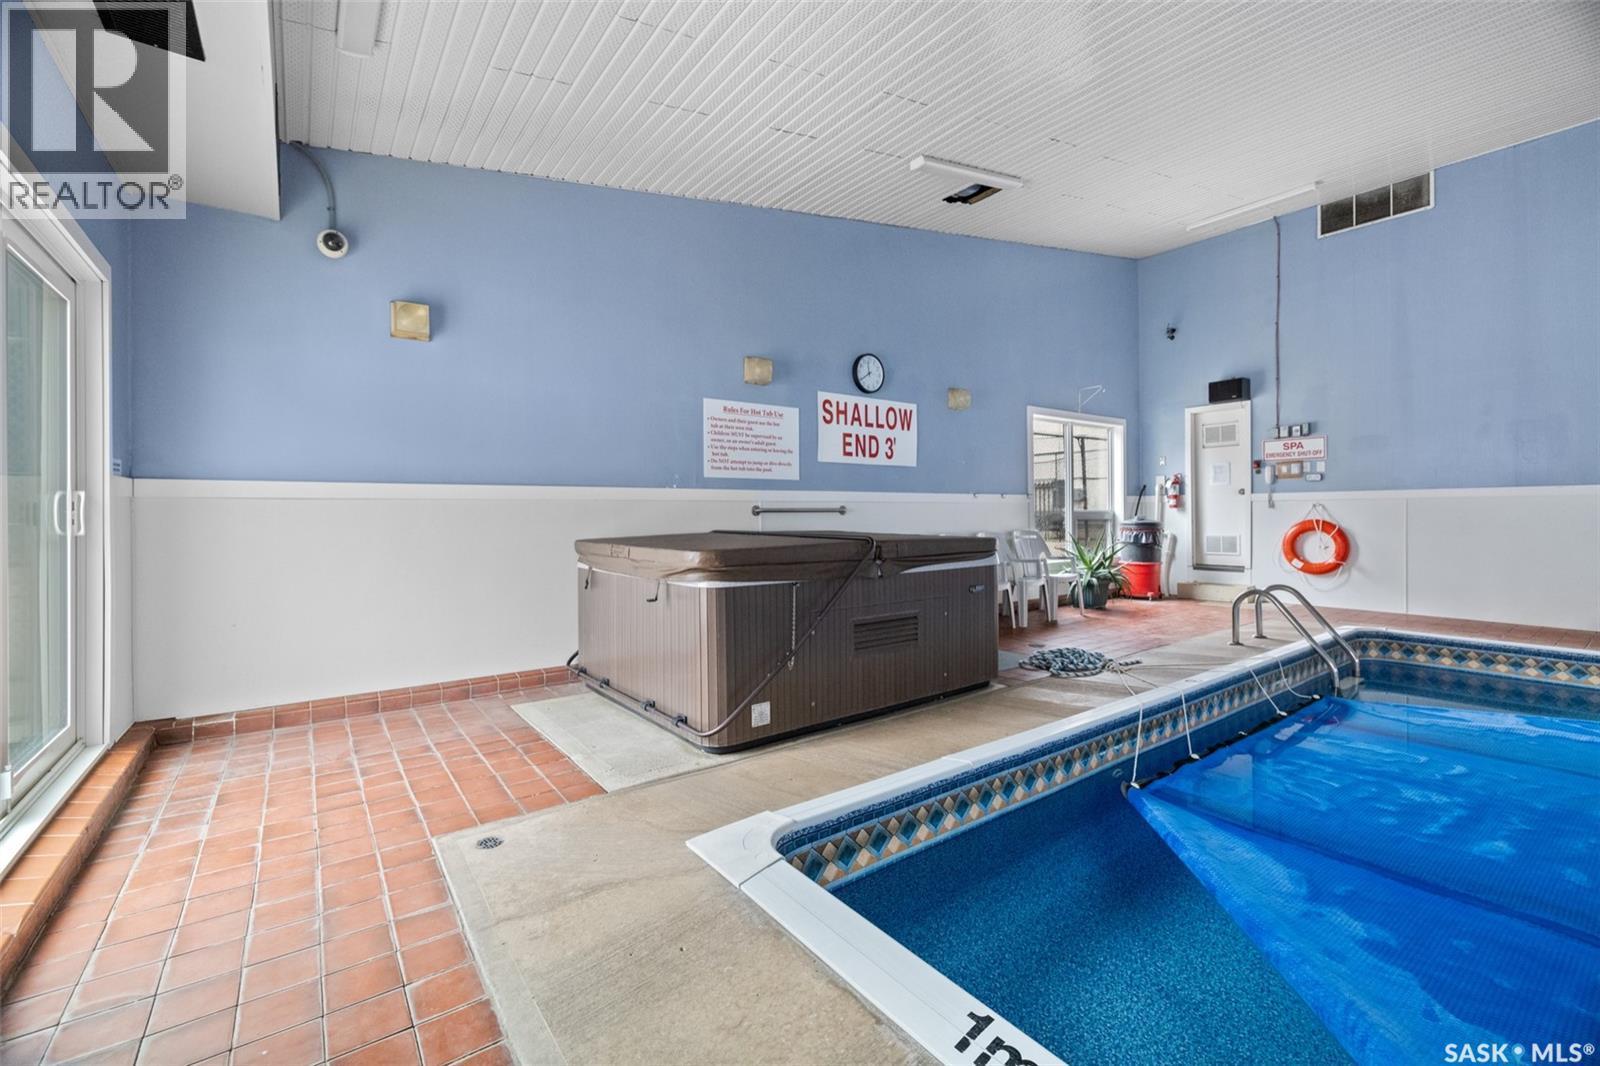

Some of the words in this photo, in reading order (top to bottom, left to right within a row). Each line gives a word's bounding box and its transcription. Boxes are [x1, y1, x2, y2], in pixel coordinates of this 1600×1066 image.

[722, 405, 739, 414] Rules
[740, 407, 749, 415] For
[751, 408, 761, 416] Hot
[762, 409, 773, 417] Tub
[774, 410, 784, 418] Use
[822, 399, 913, 431] SHALLOW
[843, 433, 879, 458] END
[885, 437, 896, 459] 3'
[1283, 441, 1304, 451] SPA
[1265, 451, 1296, 459] EMERGENCY
